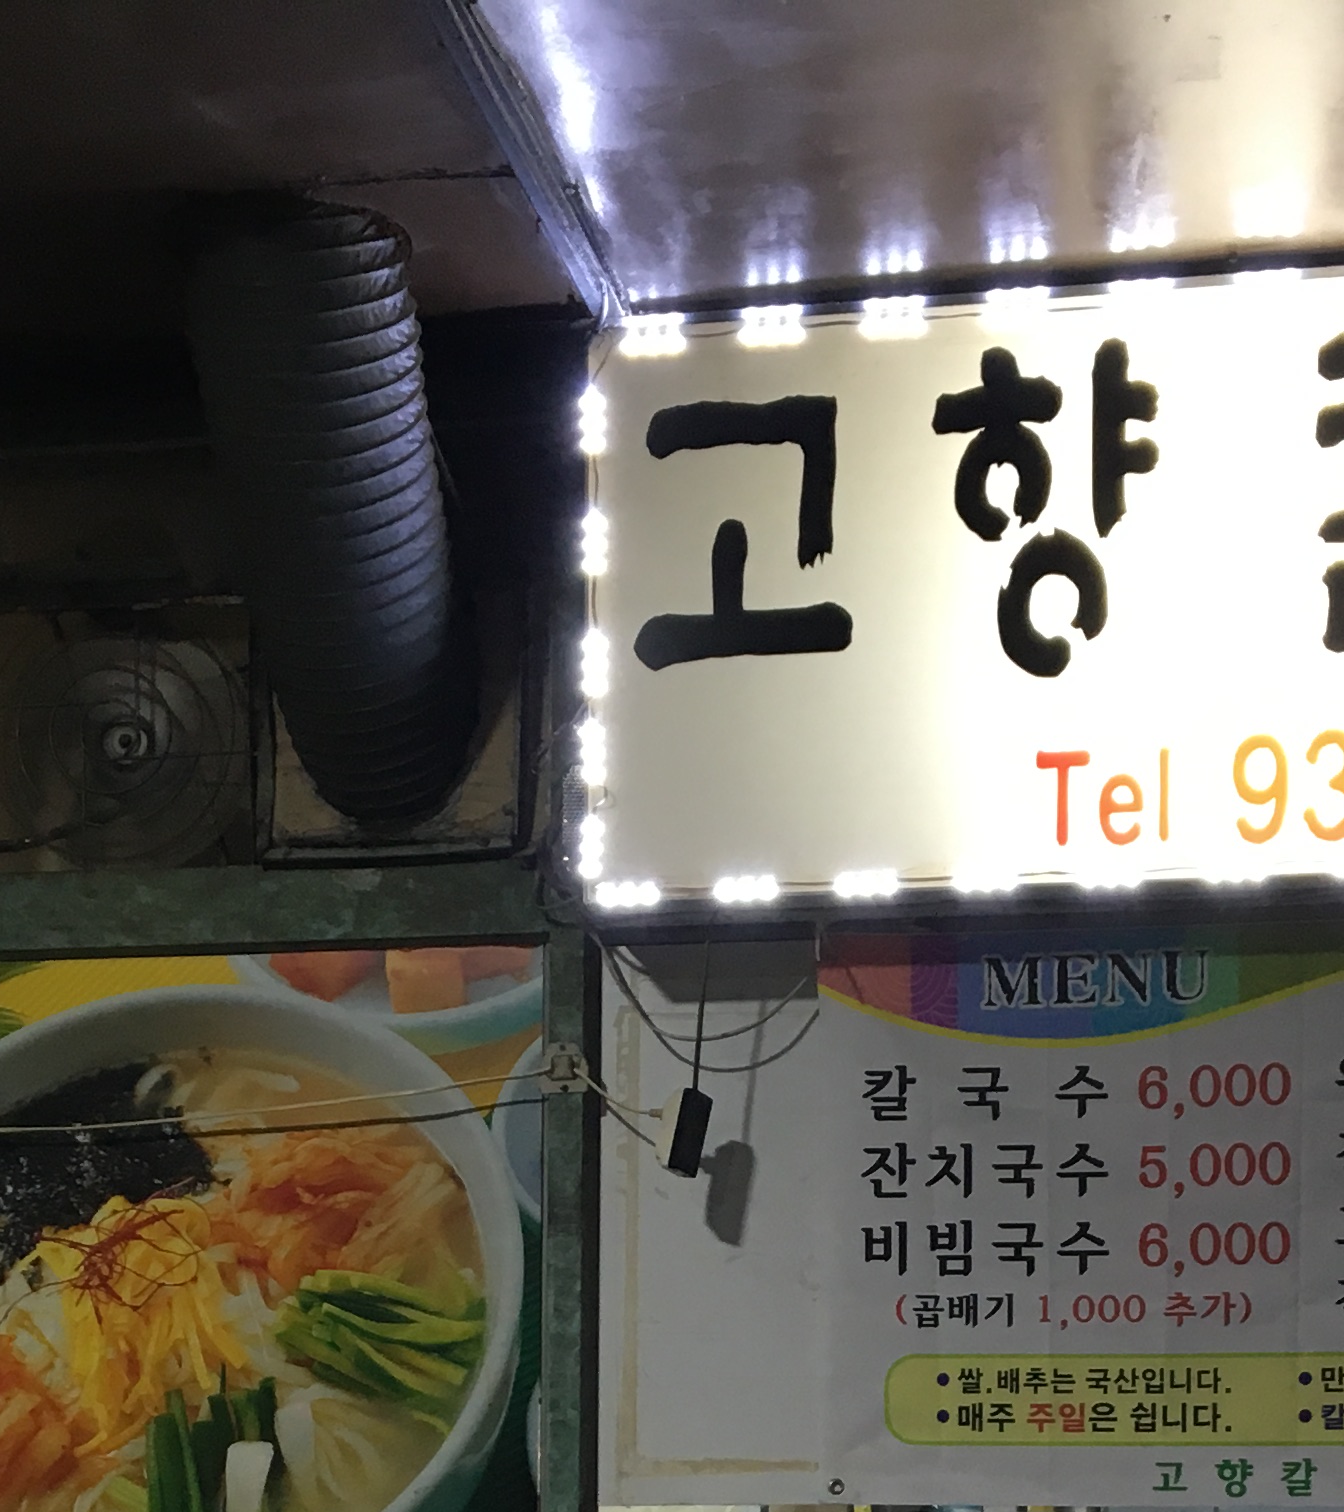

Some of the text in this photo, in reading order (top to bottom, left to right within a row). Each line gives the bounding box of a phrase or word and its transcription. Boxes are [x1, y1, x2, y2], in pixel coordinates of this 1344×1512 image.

[633, 337, 1158, 679] 고향
[1035, 745, 1171, 846] Tel
[981, 948, 1209, 1009] MENU
[1138, 1062, 1292, 1120] 6,000
[861, 1141, 1292, 1199] 잔치국수 5,000
[861, 1219, 1292, 1278] 비빔국수 6,000
[895, 1291, 1253, 1332] (곱배기 1,000 추가)
[1085, 1366, 1233, 1395] 국산입니다.
[957, 1401, 1234, 1433] 매주 주일은 쉽니다.
